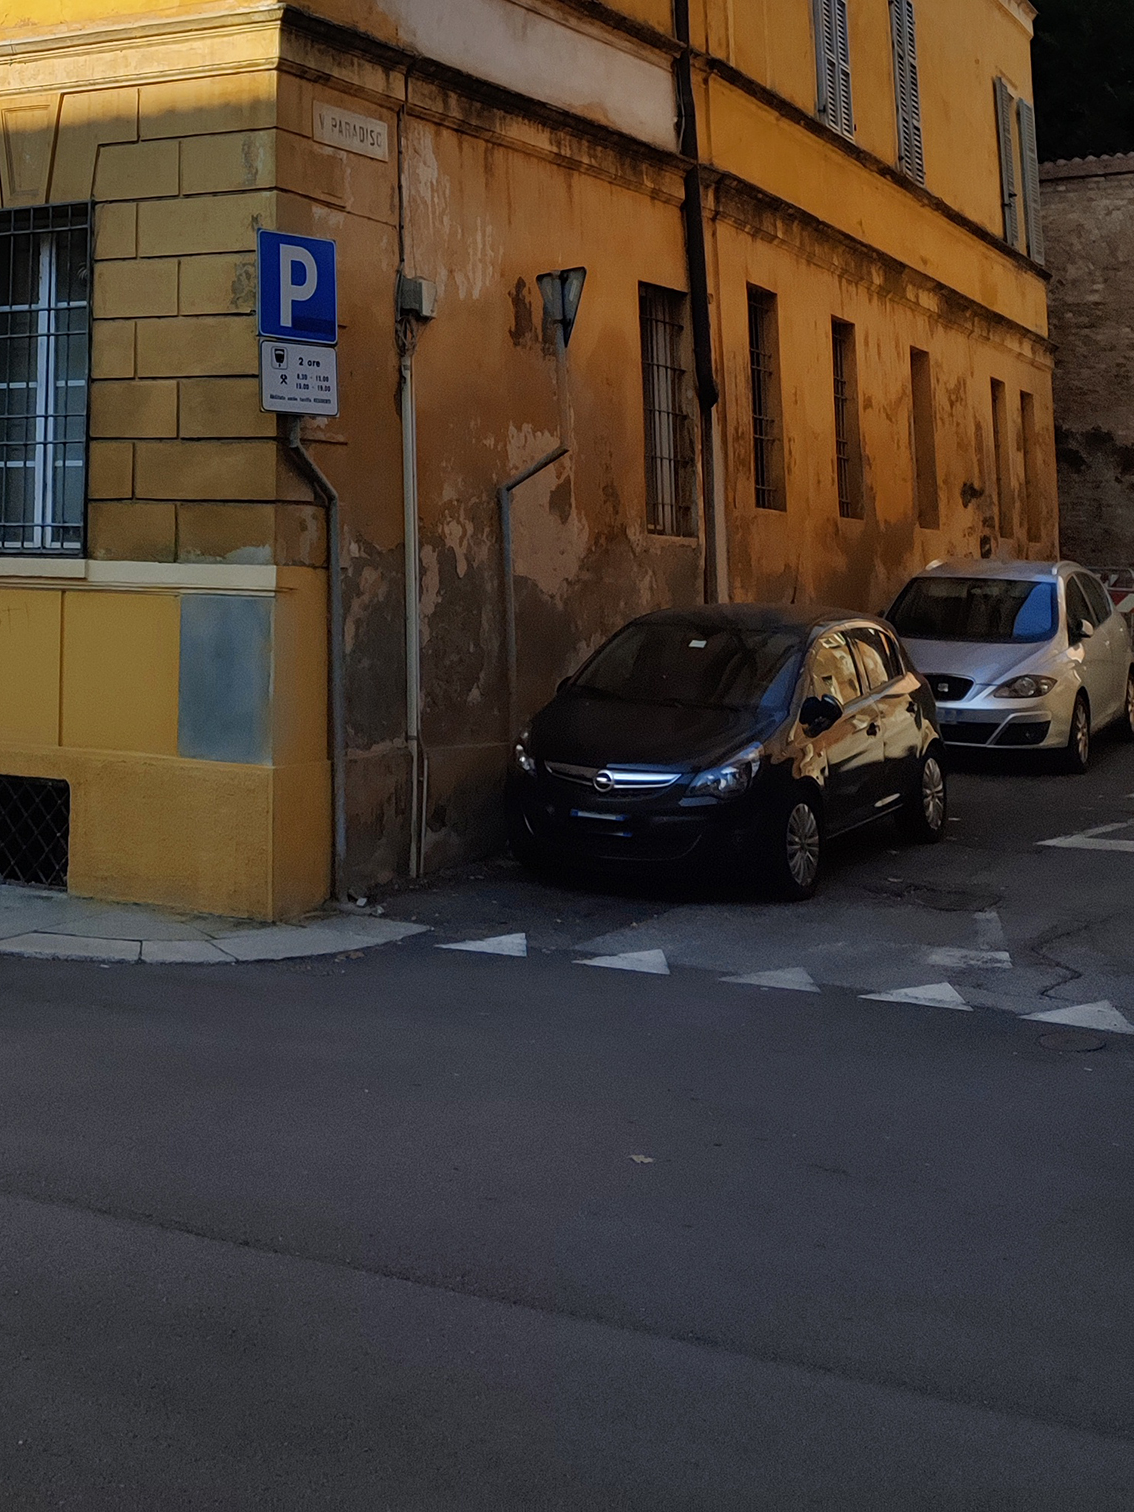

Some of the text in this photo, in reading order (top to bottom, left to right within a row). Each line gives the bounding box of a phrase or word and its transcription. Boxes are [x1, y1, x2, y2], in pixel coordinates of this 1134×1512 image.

[319, 113, 382, 147] V PARADISO
[279, 243, 318, 328] P
[298, 357, 304, 366] 2
